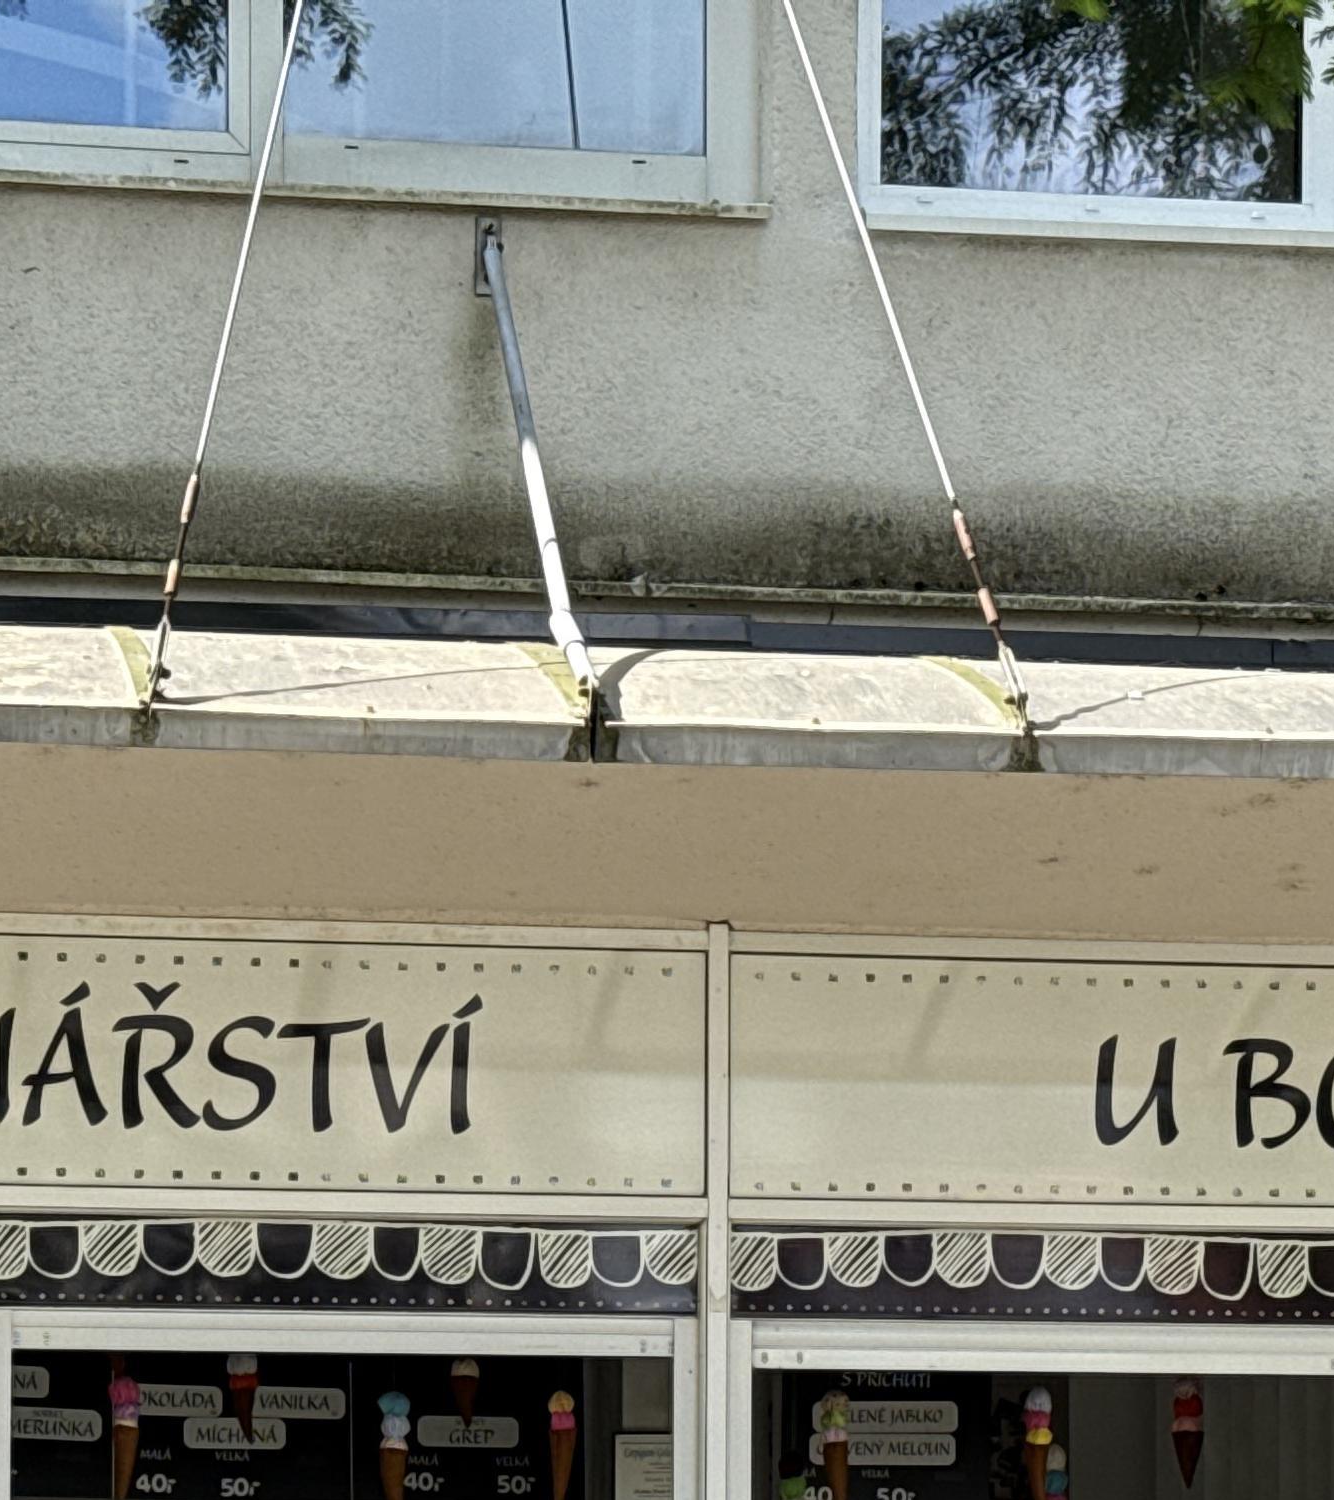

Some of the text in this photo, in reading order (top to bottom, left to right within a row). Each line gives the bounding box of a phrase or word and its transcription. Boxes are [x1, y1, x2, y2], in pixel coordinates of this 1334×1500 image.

[1095, 1034, 1180, 1147] U
[139, 1389, 216, 1409] OKOLÁDA
[258, 1391, 330, 1411] VANILKA
[448, 1428, 495, 1446] GREP
